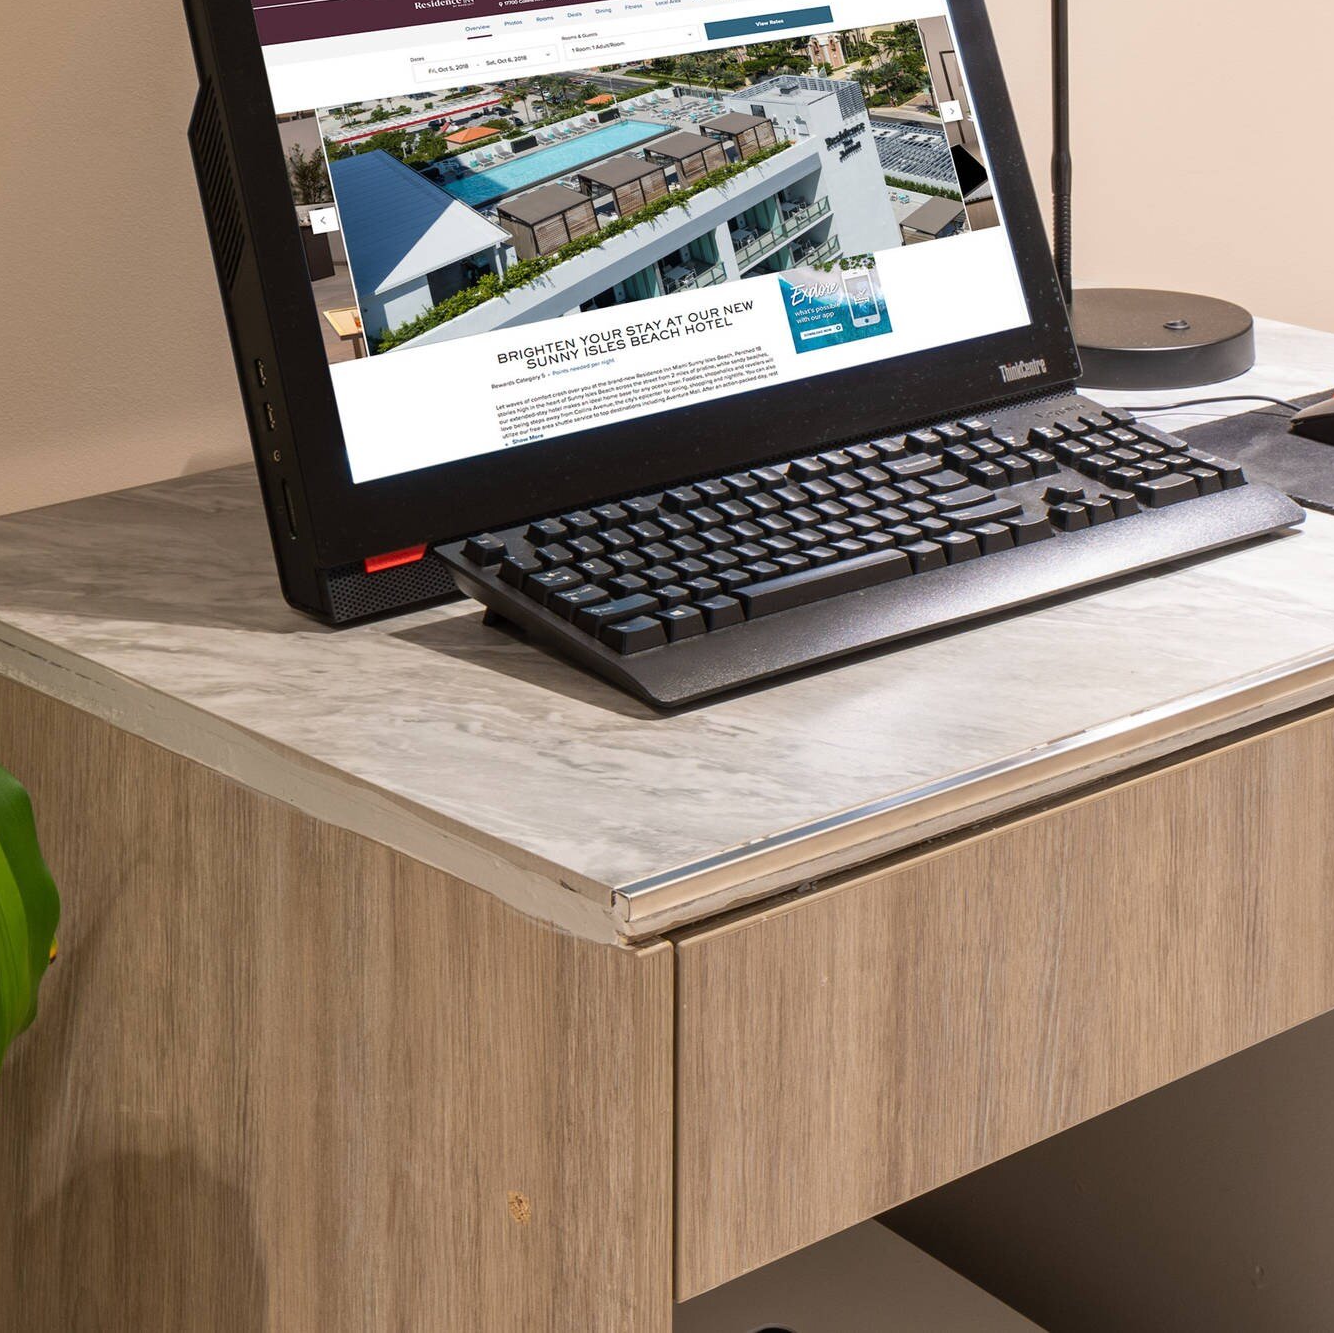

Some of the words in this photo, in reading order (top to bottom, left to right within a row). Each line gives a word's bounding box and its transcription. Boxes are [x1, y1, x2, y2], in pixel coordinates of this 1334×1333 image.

[464, 24, 491, 32] Overview
[790, 281, 838, 306] Explore
[794, 307, 815, 317] what's
[814, 300, 841, 313] possible
[795, 316, 810, 324] with
[821, 311, 835, 319] app
[496, 338, 576, 364] BRIGHTEN
[579, 328, 622, 346] YOUR
[624, 319, 661, 336] STAY
[665, 314, 683, 328] AT
[686, 307, 720, 323] OUR
[722, 300, 753, 315] NEW
[525, 348, 579, 370] SUNNY
[583, 339, 626, 357] ISLES
[629, 327, 680, 347] BEACH
[684, 316, 732, 335] HOTEL
[505, 400, 523, 408] waves
[530, 393, 552, 403] comfort
[551, 390, 567, 398] crash
[606, 375, 635, 385] brand-new
[635, 368, 663, 379] Residence
[671, 362, 688, 370] Miami
[687, 359, 705, 368] Sunny
[733, 347, 755, 356] Perched
[551, 368, 569, 376] Points
[569, 363, 591, 372] needed
[600, 357, 615, 366] night
[998, 358, 1047, 383] ThinkCentre
[490, 380, 515, 390] Rewards
[514, 374, 541, 385] Category
[496, 409, 516, 418] stories
[516, 406, 530, 414] high
[545, 399, 560, 407] heart
[566, 393, 585, 402] Sunny
[597, 386, 615, 395] Beach
[614, 383, 633, 391] across
[642, 377, 658, 385] street
[730, 357, 746, 365] sandy
[501, 431, 519, 439] utilize
[554, 418, 573, 427] shuttle
[573, 414, 593, 422] service
[609, 403, 641, 414] destinations
[641, 397, 666, 407] including
[665, 391, 689, 401] Aventura
[721, 375, 757, 388] action-packed
[511, 436, 528, 445] Show
